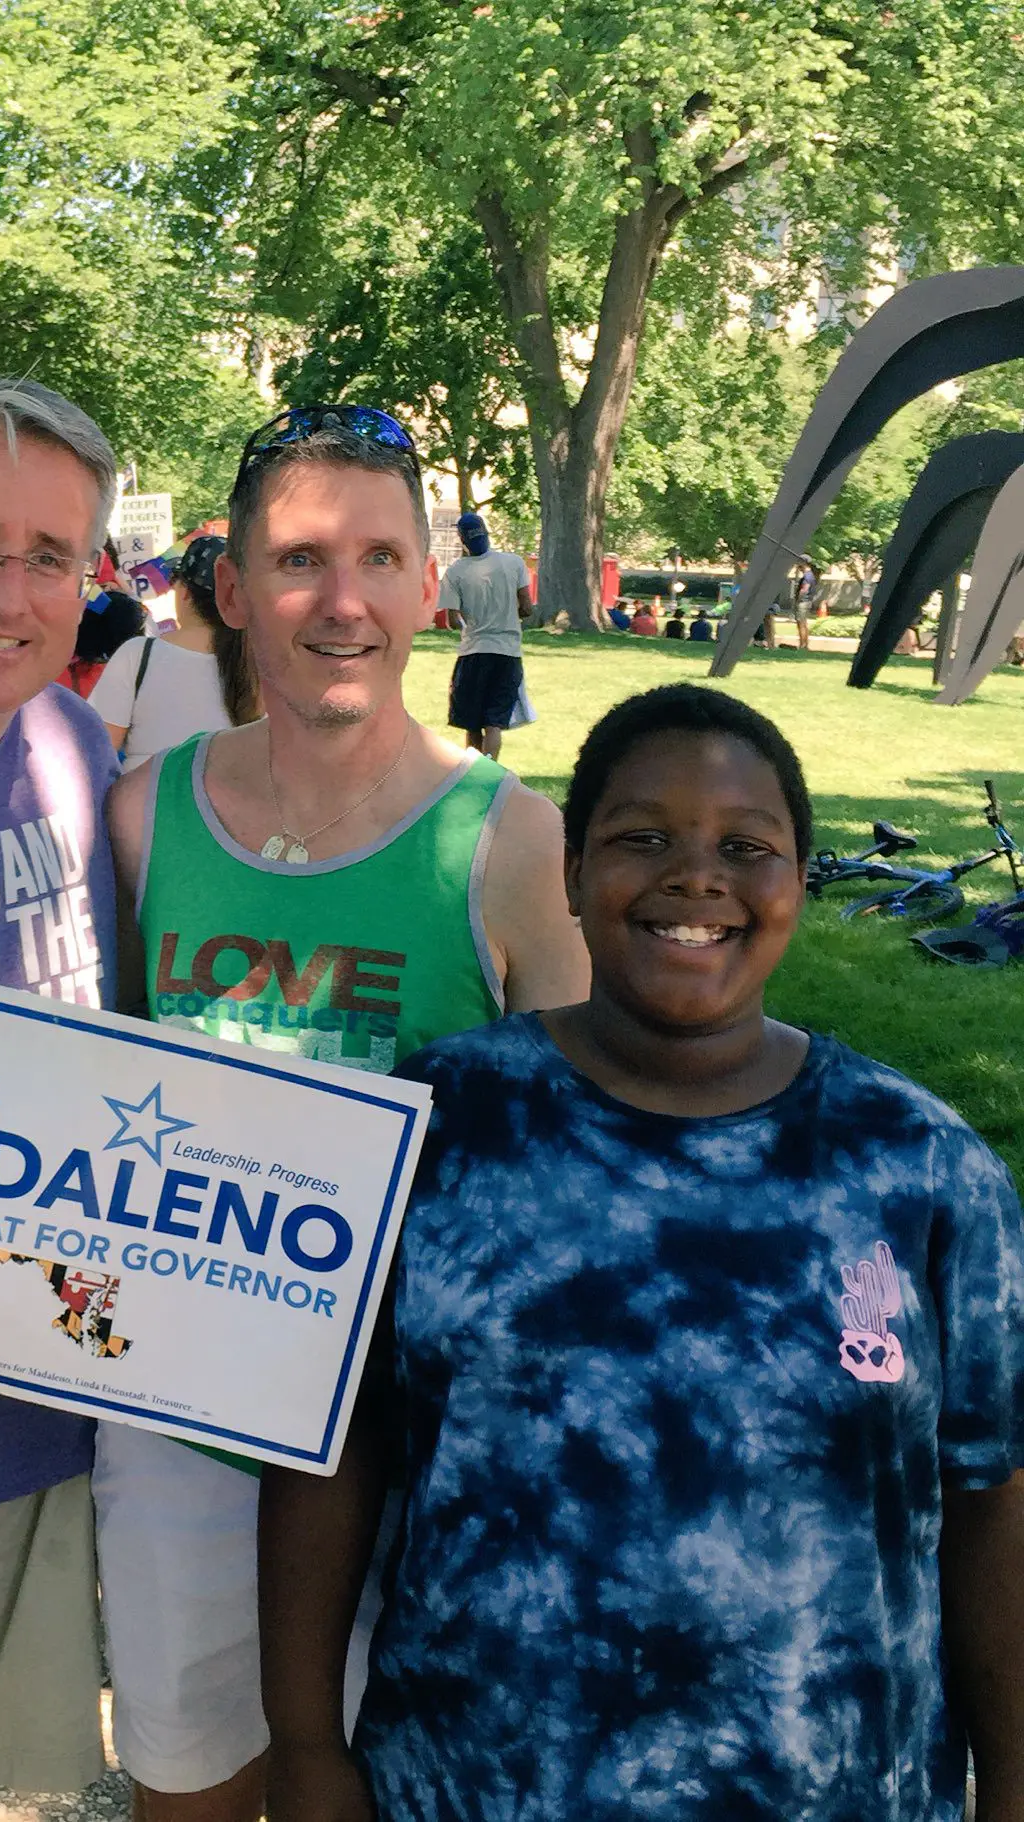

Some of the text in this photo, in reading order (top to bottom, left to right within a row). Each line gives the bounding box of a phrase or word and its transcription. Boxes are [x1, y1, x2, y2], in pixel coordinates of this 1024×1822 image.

[6, 885, 101, 984] THE
[156, 932, 406, 1016] LOVE
[157, 992, 398, 1038] conquers
[173, 1141, 339, 1197] Leadership. Progress
[34, 1223, 111, 1264] FOR
[121, 1243, 337, 1318] GOVERNOR
[13, 1364, 26, 1374] for
[75, 1378, 99, 1391] Linda
